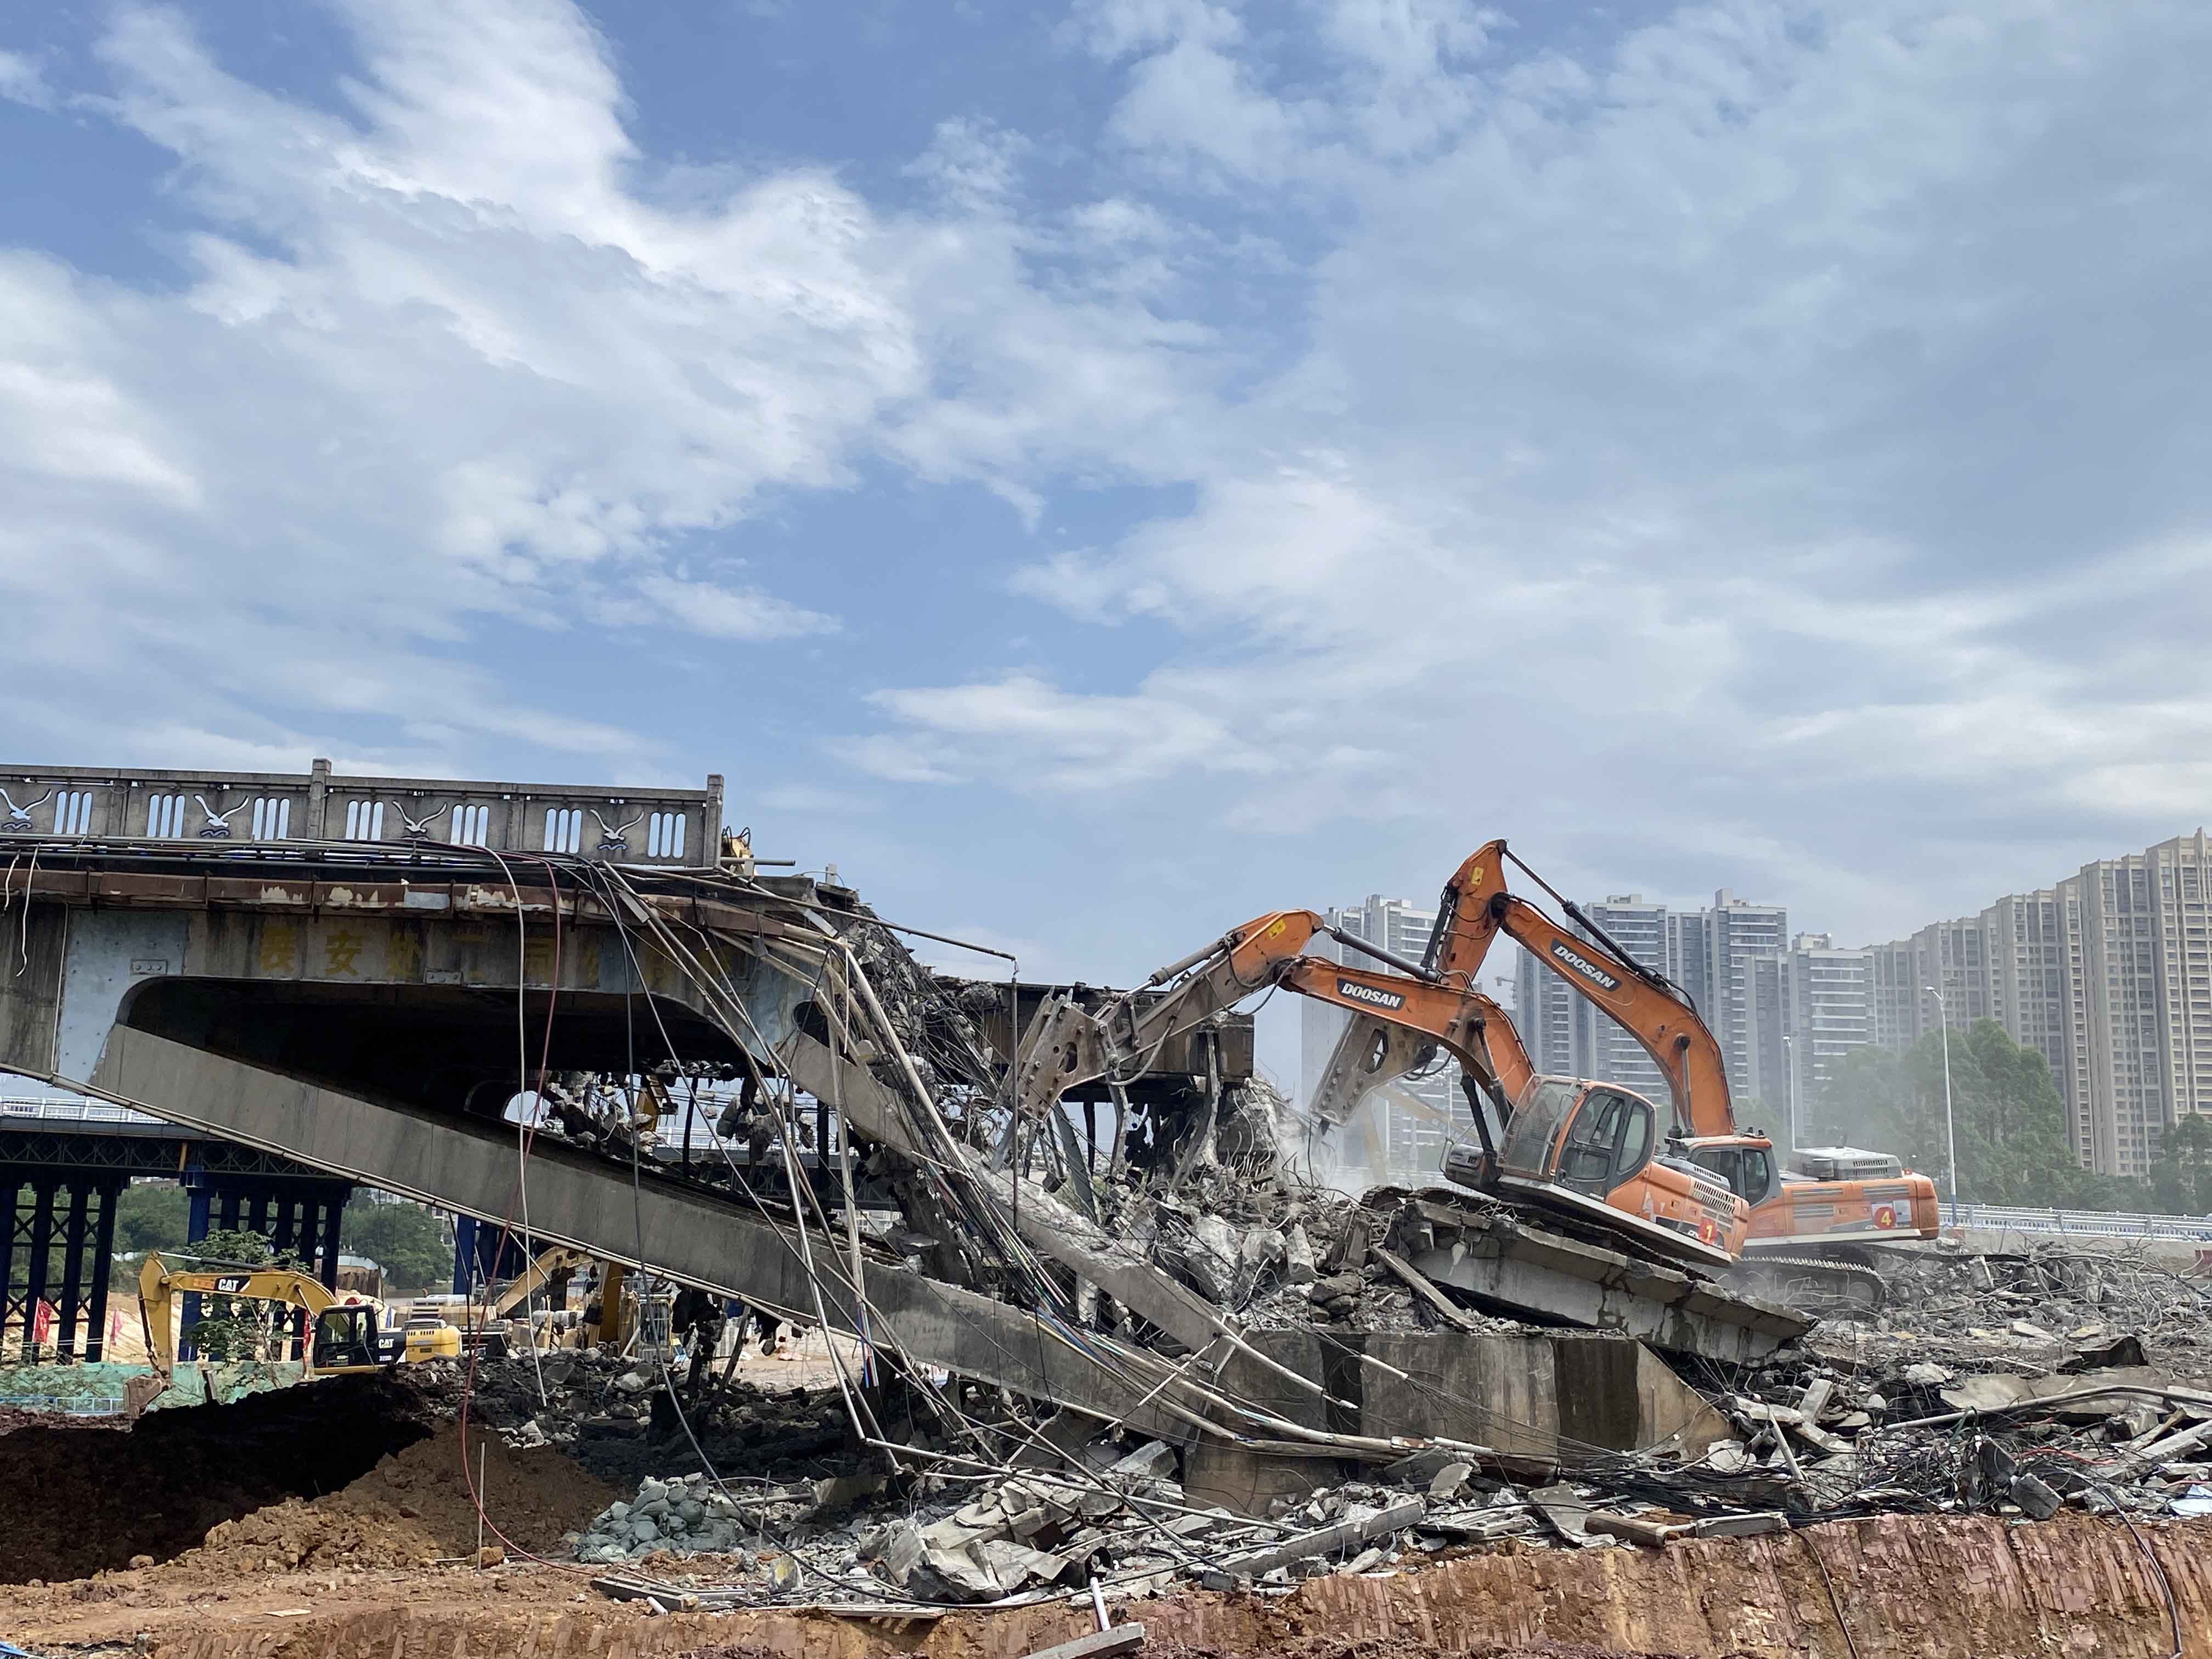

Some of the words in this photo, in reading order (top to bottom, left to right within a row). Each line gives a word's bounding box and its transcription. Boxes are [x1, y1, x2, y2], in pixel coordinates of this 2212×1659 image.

[1553, 945, 1616, 988] DOOSAN
[1341, 983, 1401, 1007] DOOSAN
[1880, 1210, 1892, 1226] 4
[1706, 1224, 1713, 1240] 1
[218, 1279, 239, 1292] CAT
[379, 1339, 394, 1348] CAT
